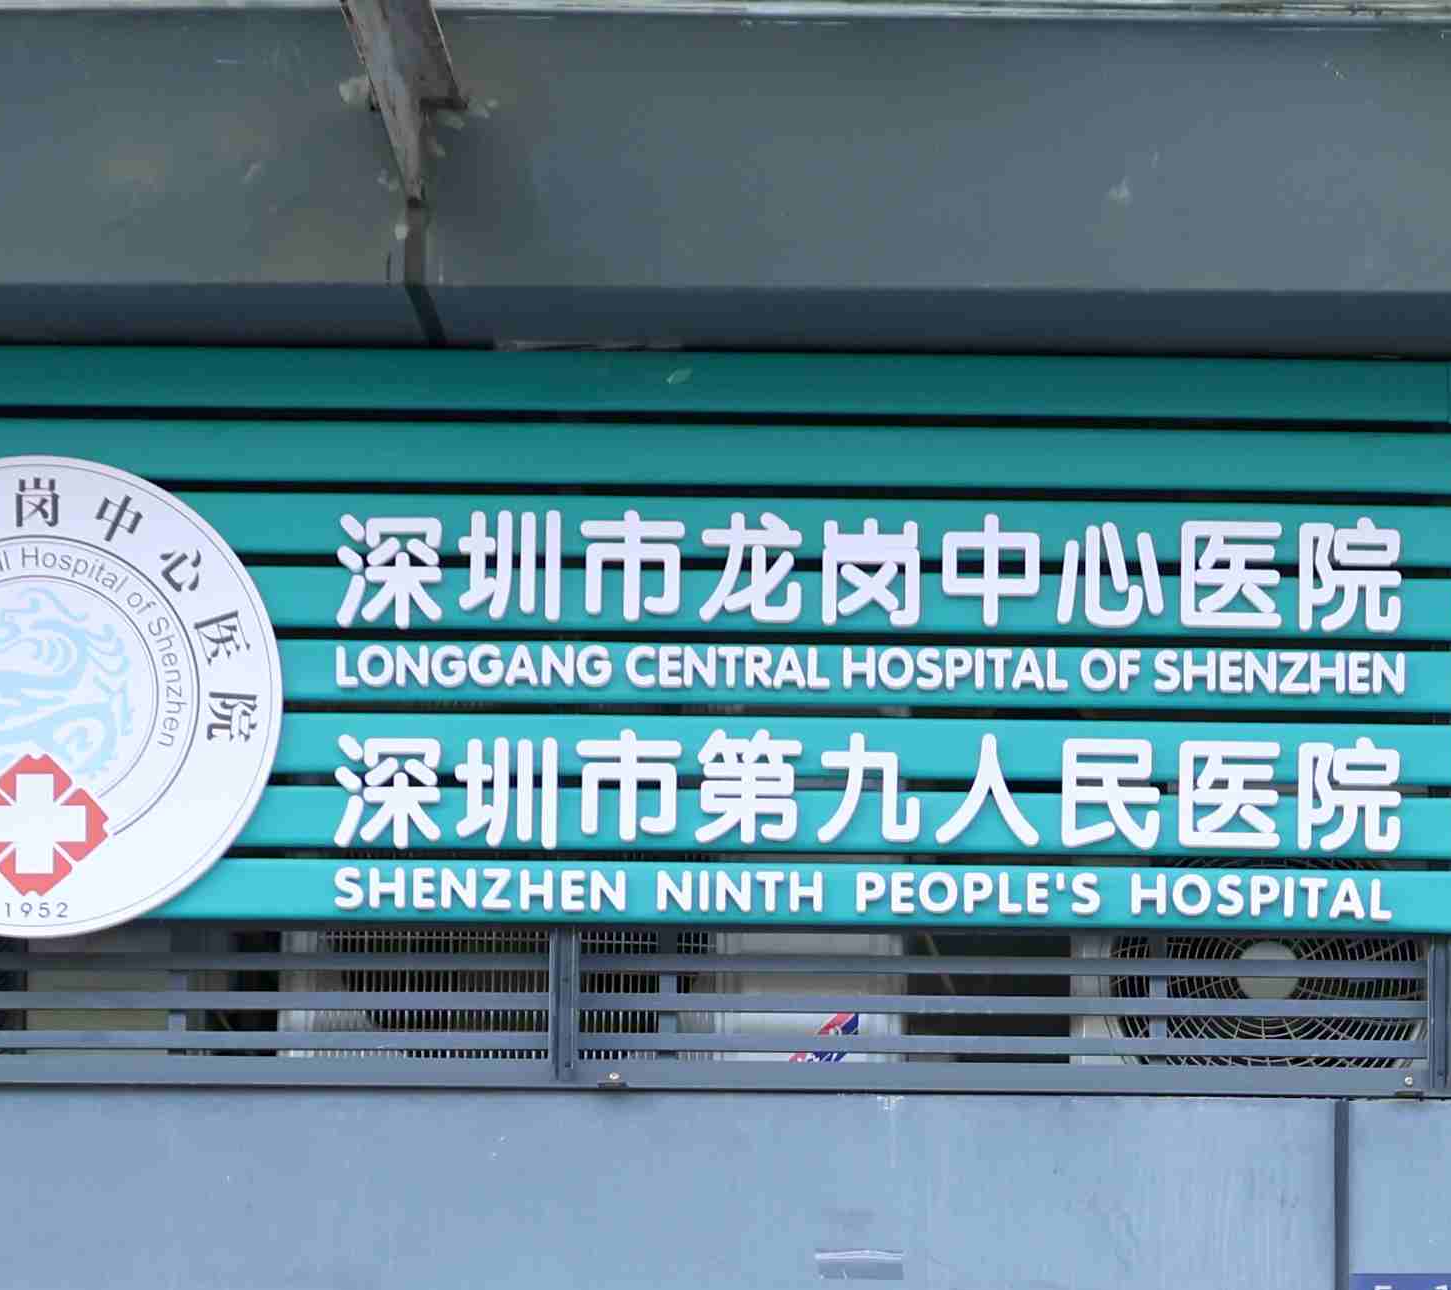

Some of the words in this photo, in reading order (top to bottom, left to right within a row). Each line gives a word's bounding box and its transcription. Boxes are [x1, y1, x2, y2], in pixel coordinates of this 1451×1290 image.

[336, 509, 1403, 633] 深圳市龙岗中心医院
[20, 546, 126, 596] Hospital
[126, 588, 156, 617] of
[147, 616, 188, 749] Shenzhen
[334, 645, 613, 688] LONGGANG
[625, 645, 831, 690] CENTRAL
[843, 646, 1069, 692] HOSPITAL
[1080, 650, 1141, 692] OF
[1153, 651, 1406, 696] SHENZHEN
[334, 728, 1403, 852] 深圳市第九人民医院
[3, 902, 70, 920] 1952
[334, 866, 627, 913] SHENZHEN
[656, 870, 824, 914] NINTH
[855, 870, 1102, 917] PEOPLE'S
[1130, 873, 1392, 923] HOSPITAL
